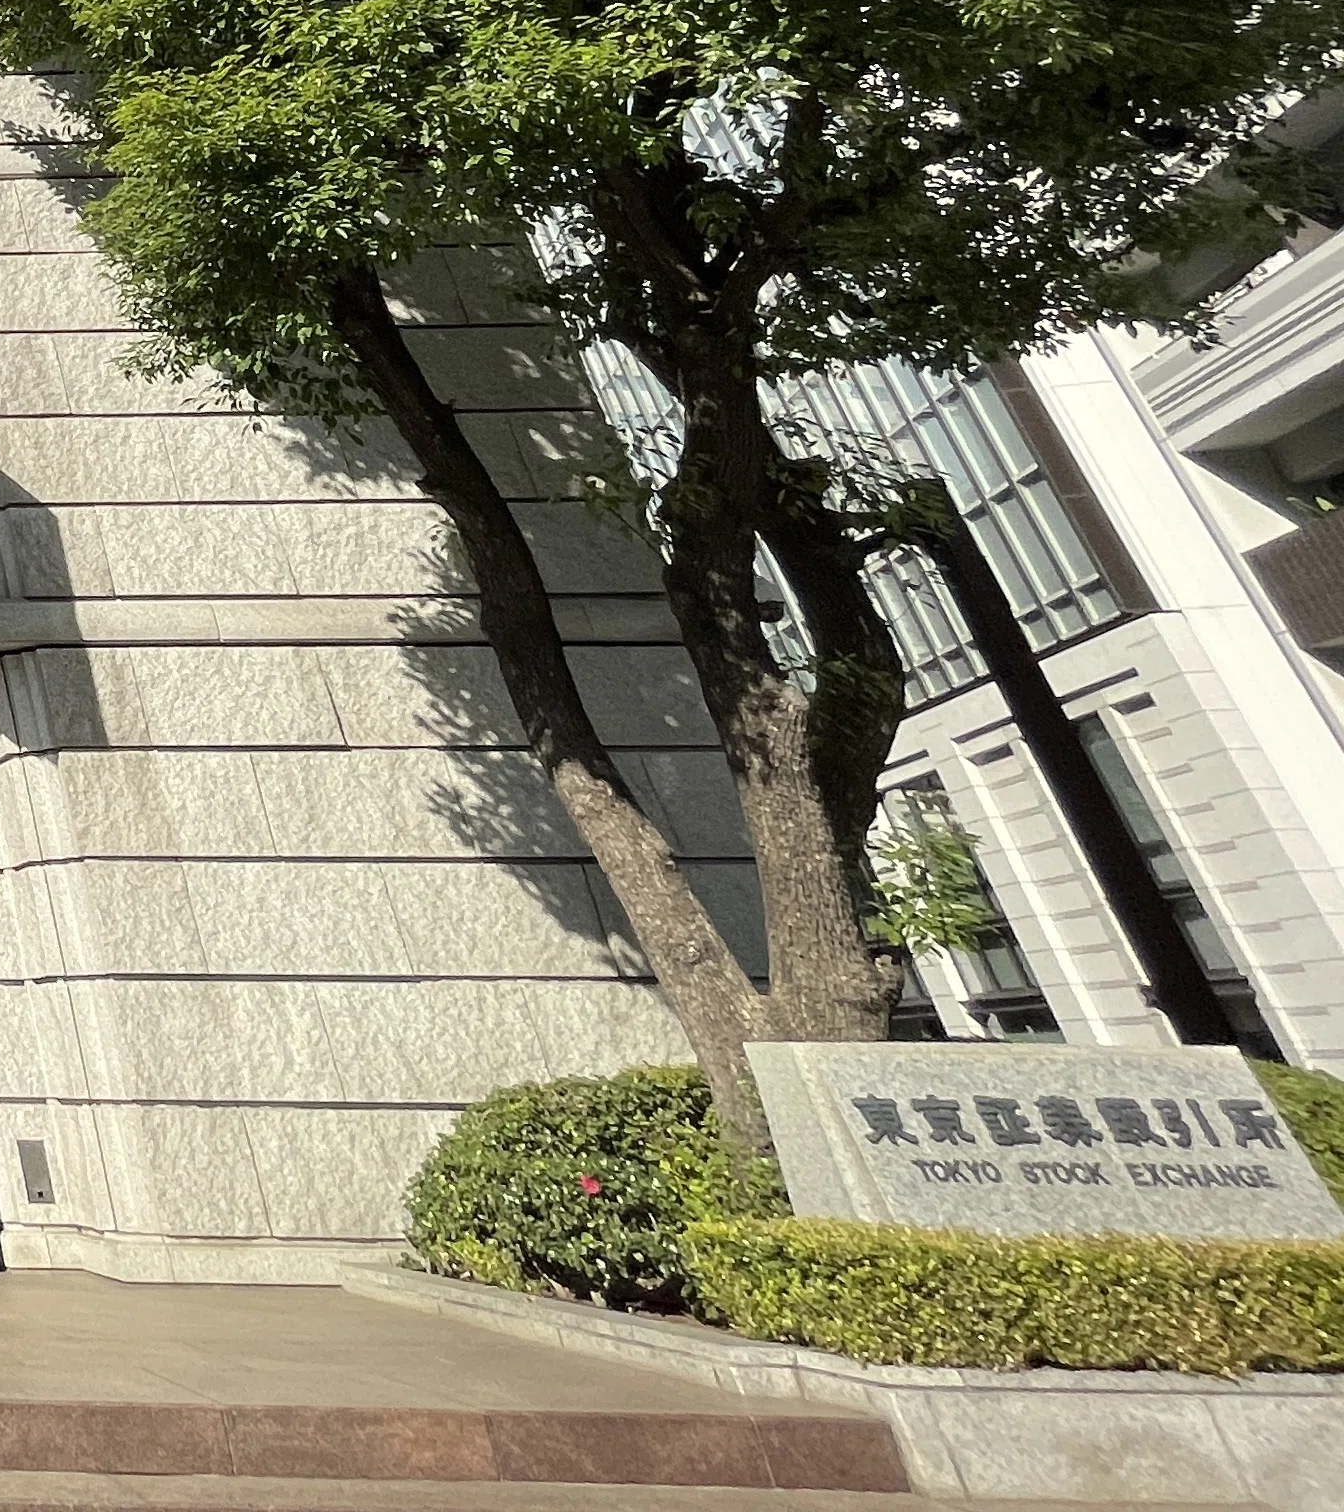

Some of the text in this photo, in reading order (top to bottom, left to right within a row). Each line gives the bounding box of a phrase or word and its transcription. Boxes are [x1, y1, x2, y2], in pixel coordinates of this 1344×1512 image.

[850, 1092, 1287, 1151] 東京証券取引所
[909, 1158, 1282, 1190] TOKYO STOCK EXCHANGE
